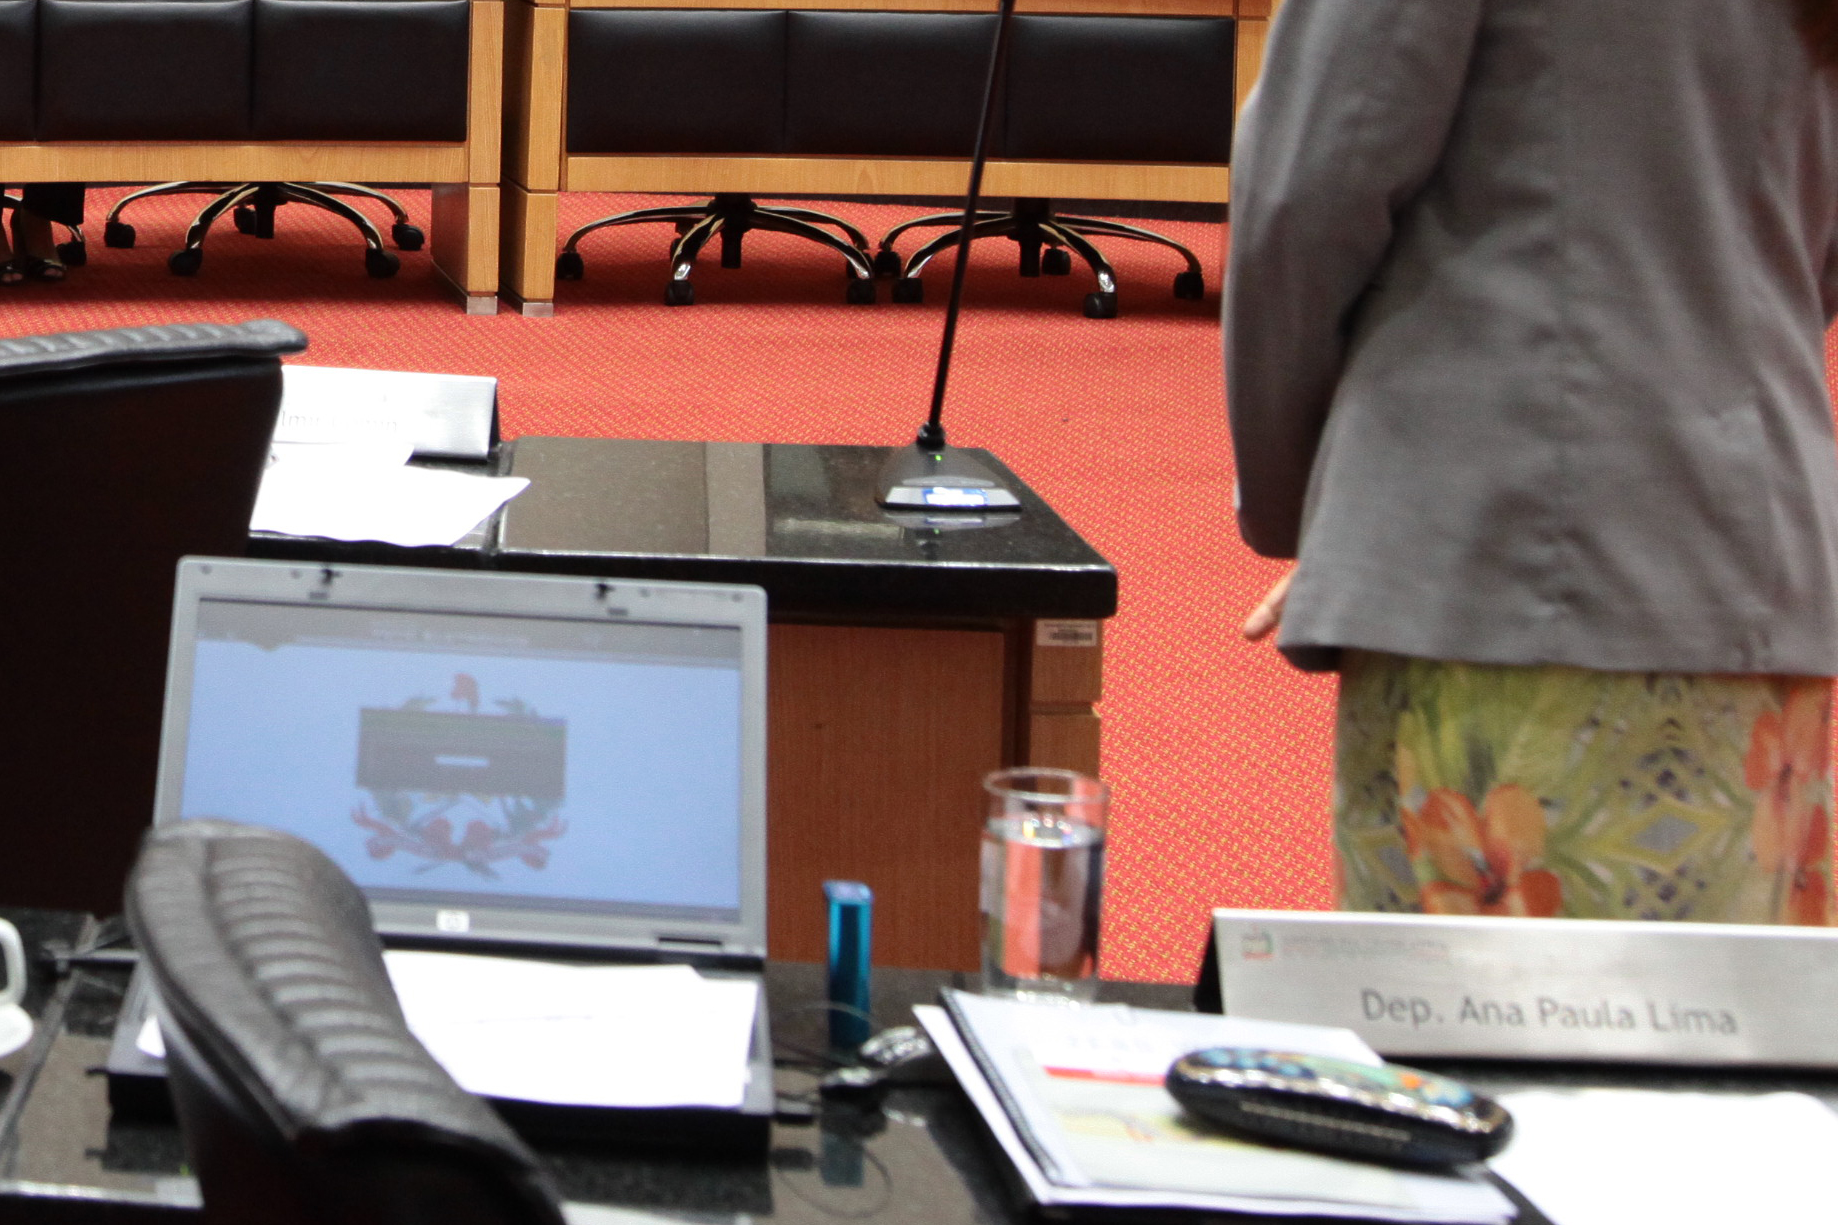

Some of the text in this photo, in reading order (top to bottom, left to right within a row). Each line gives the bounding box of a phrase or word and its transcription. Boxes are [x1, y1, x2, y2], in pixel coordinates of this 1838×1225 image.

[1361, 989, 1739, 1035] Dep. Ana Paula Lima
